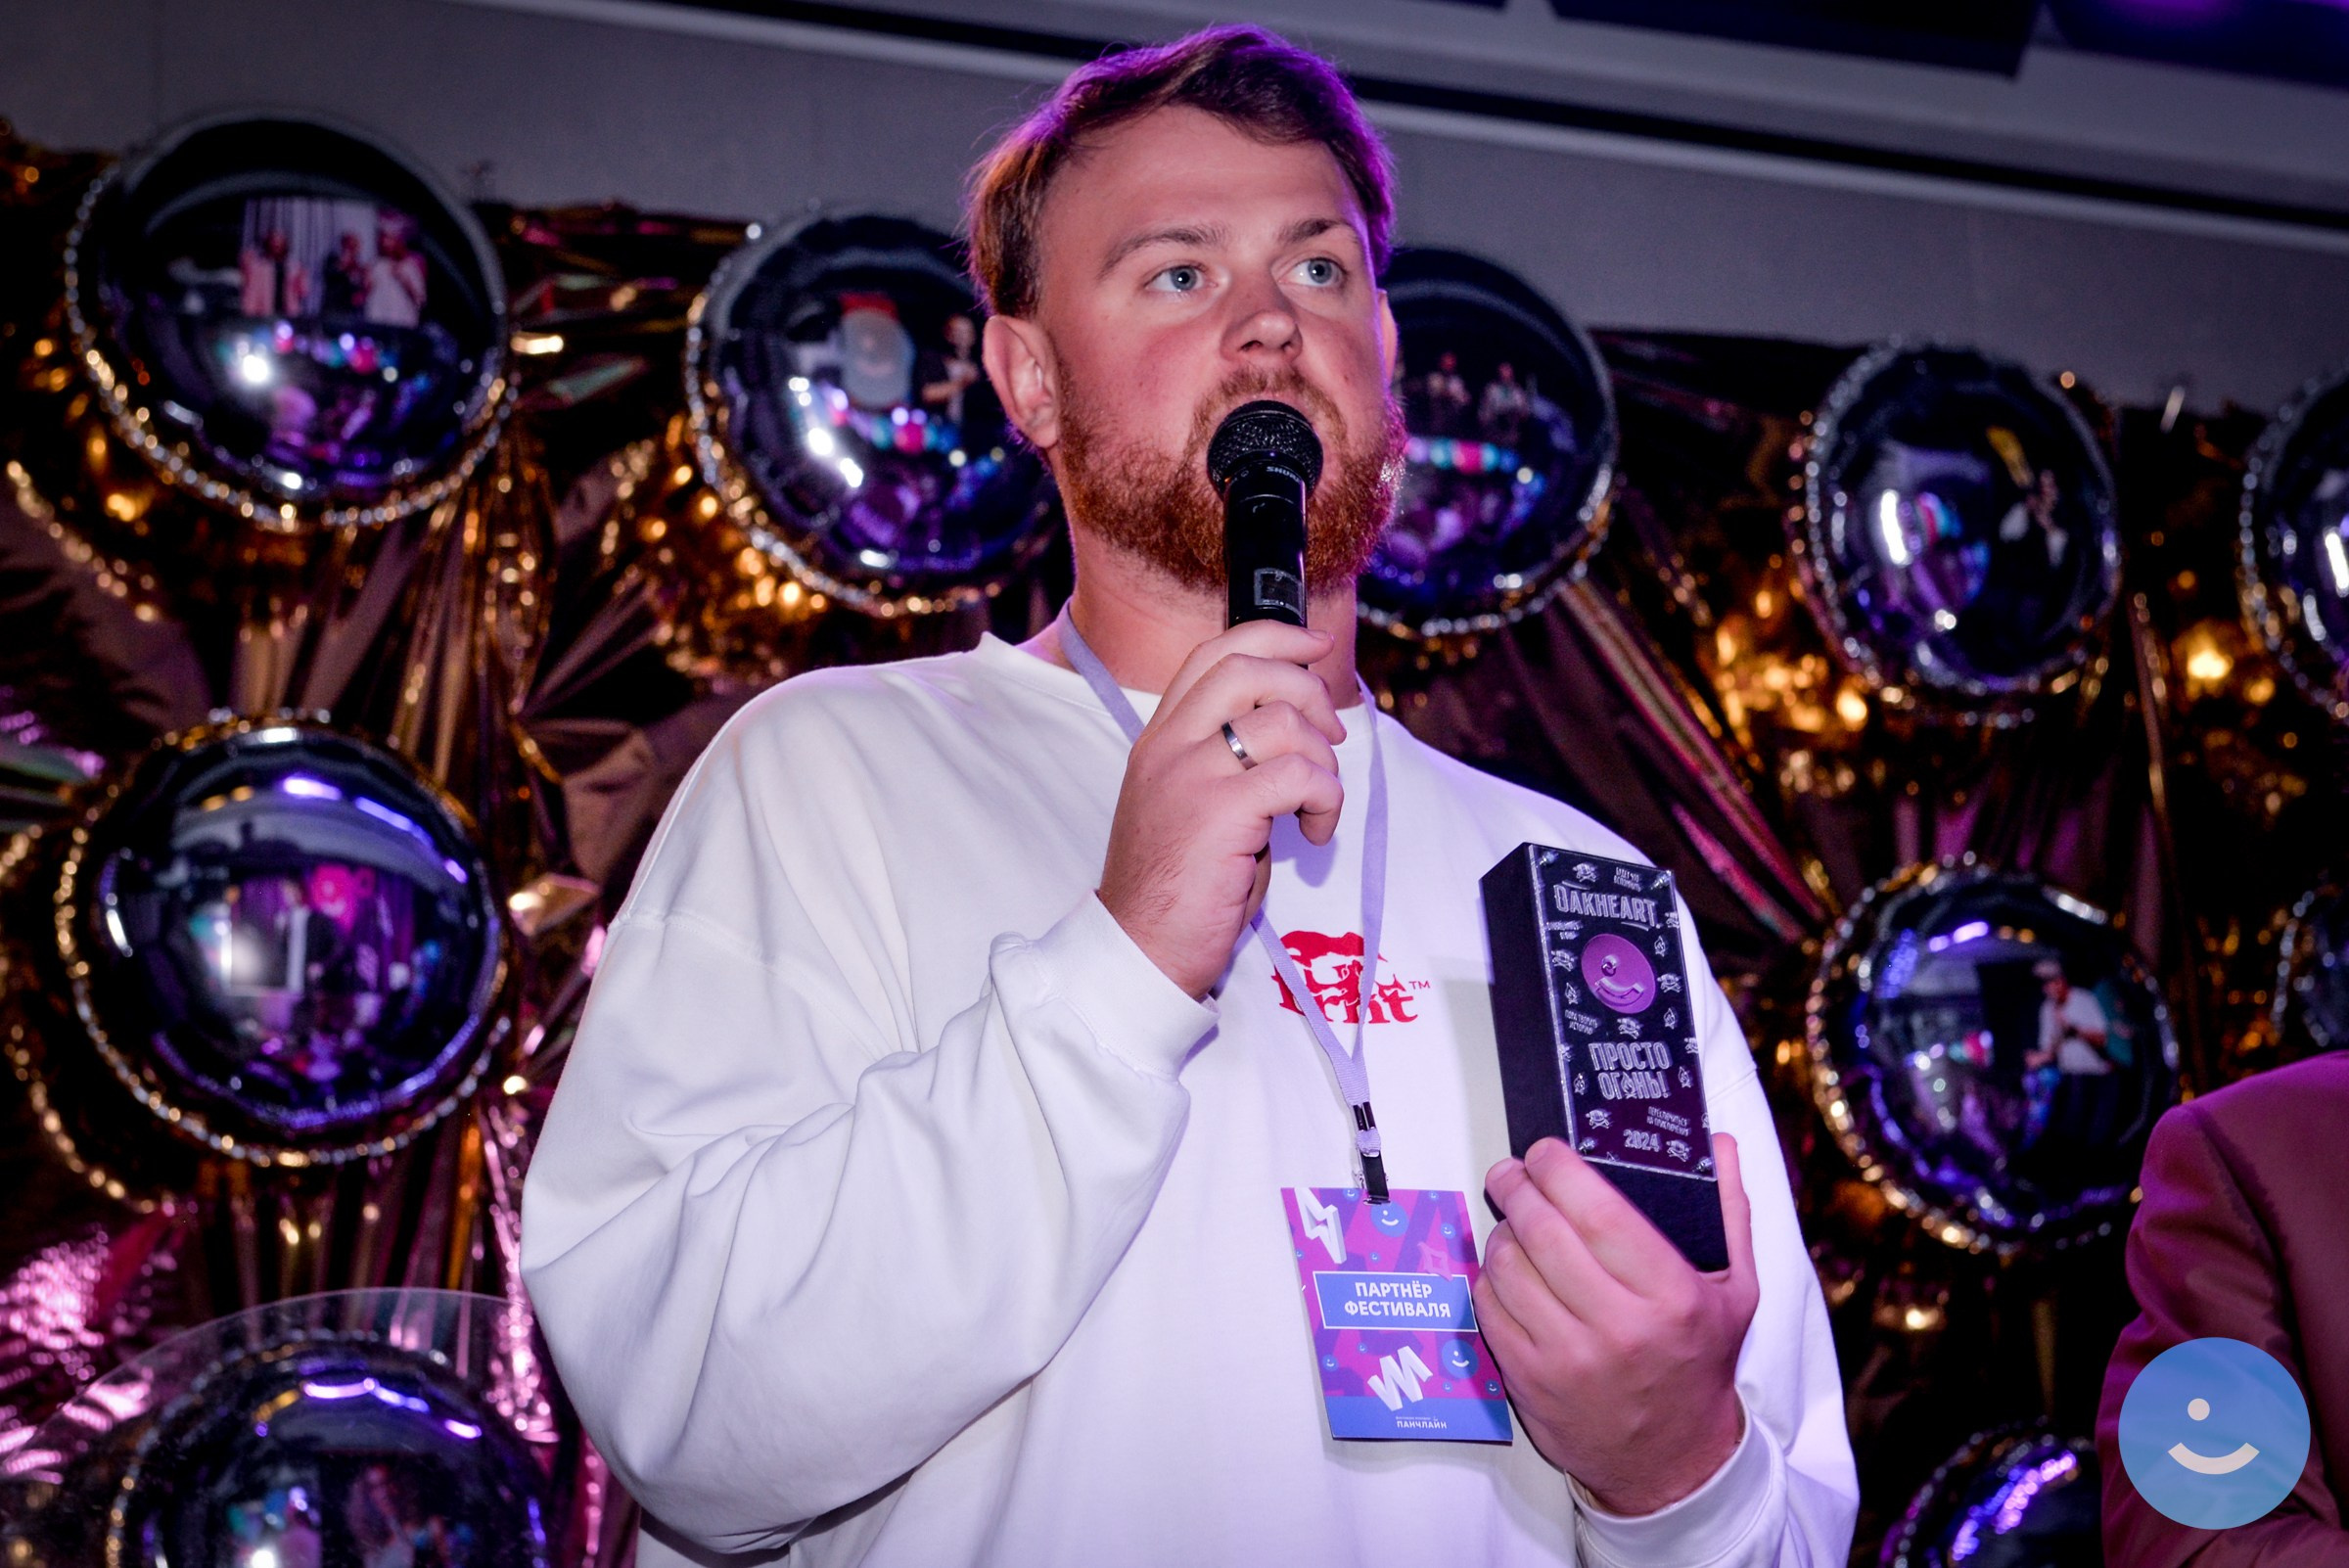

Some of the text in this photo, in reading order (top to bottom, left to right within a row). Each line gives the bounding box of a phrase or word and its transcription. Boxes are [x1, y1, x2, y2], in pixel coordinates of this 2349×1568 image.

[1588, 1041, 1671, 1071] ПРОСТО
[1623, 1129, 1660, 1152] 2024
[1355, 1280, 1432, 1299] ПАРТНЁР
[1344, 1301, 1451, 1318] ФЕСТИВАЛЯ
